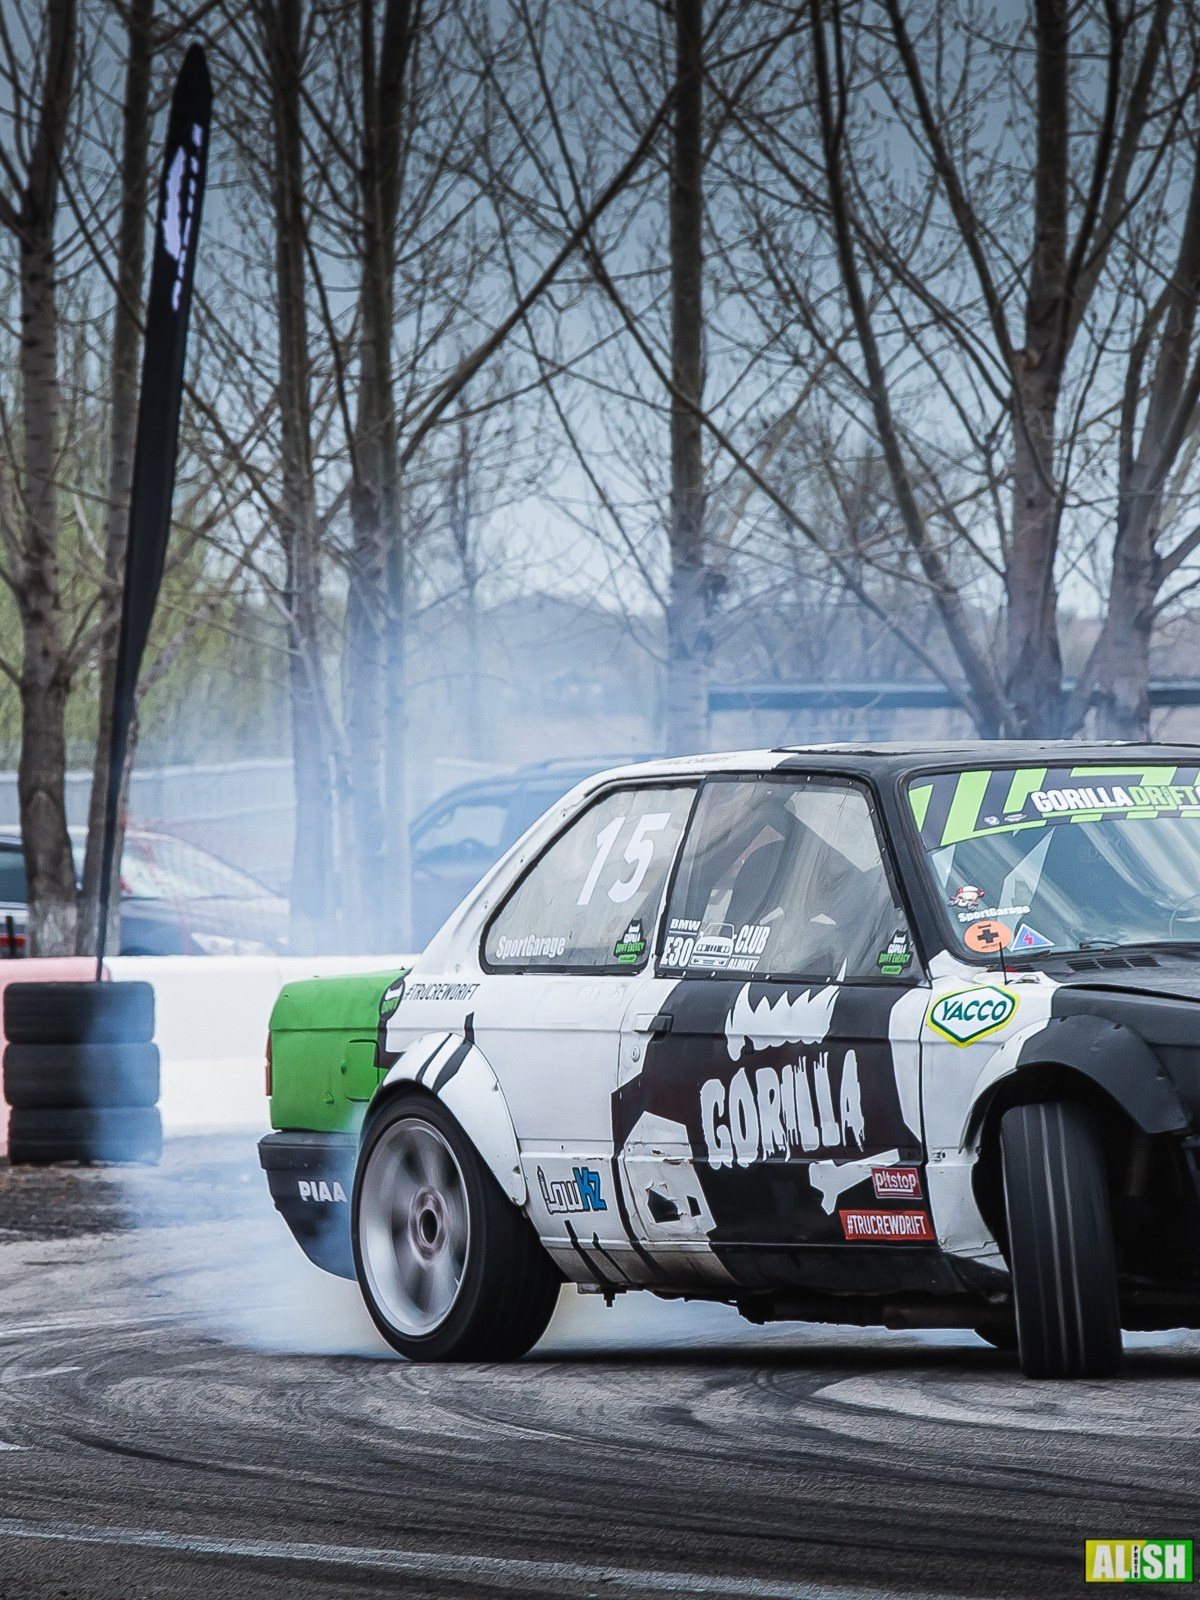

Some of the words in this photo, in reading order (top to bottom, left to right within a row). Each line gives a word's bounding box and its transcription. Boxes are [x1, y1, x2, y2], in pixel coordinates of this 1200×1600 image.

[577, 812, 672, 906] 15
[957, 905, 1031, 922] SportGarage
[670, 919, 701, 931] BMW
[495, 934, 566, 960] SportGarage
[734, 924, 770, 954] CLUB
[660, 936, 694, 967] E30
[727, 958, 759, 971] ALMATY
[941, 1000, 1007, 1021] YACCO
[700, 1049, 865, 1170] GORILLA
[298, 1181, 347, 1202] PIAA
[847, 1215, 927, 1235] #TRUCREWDRIFT
